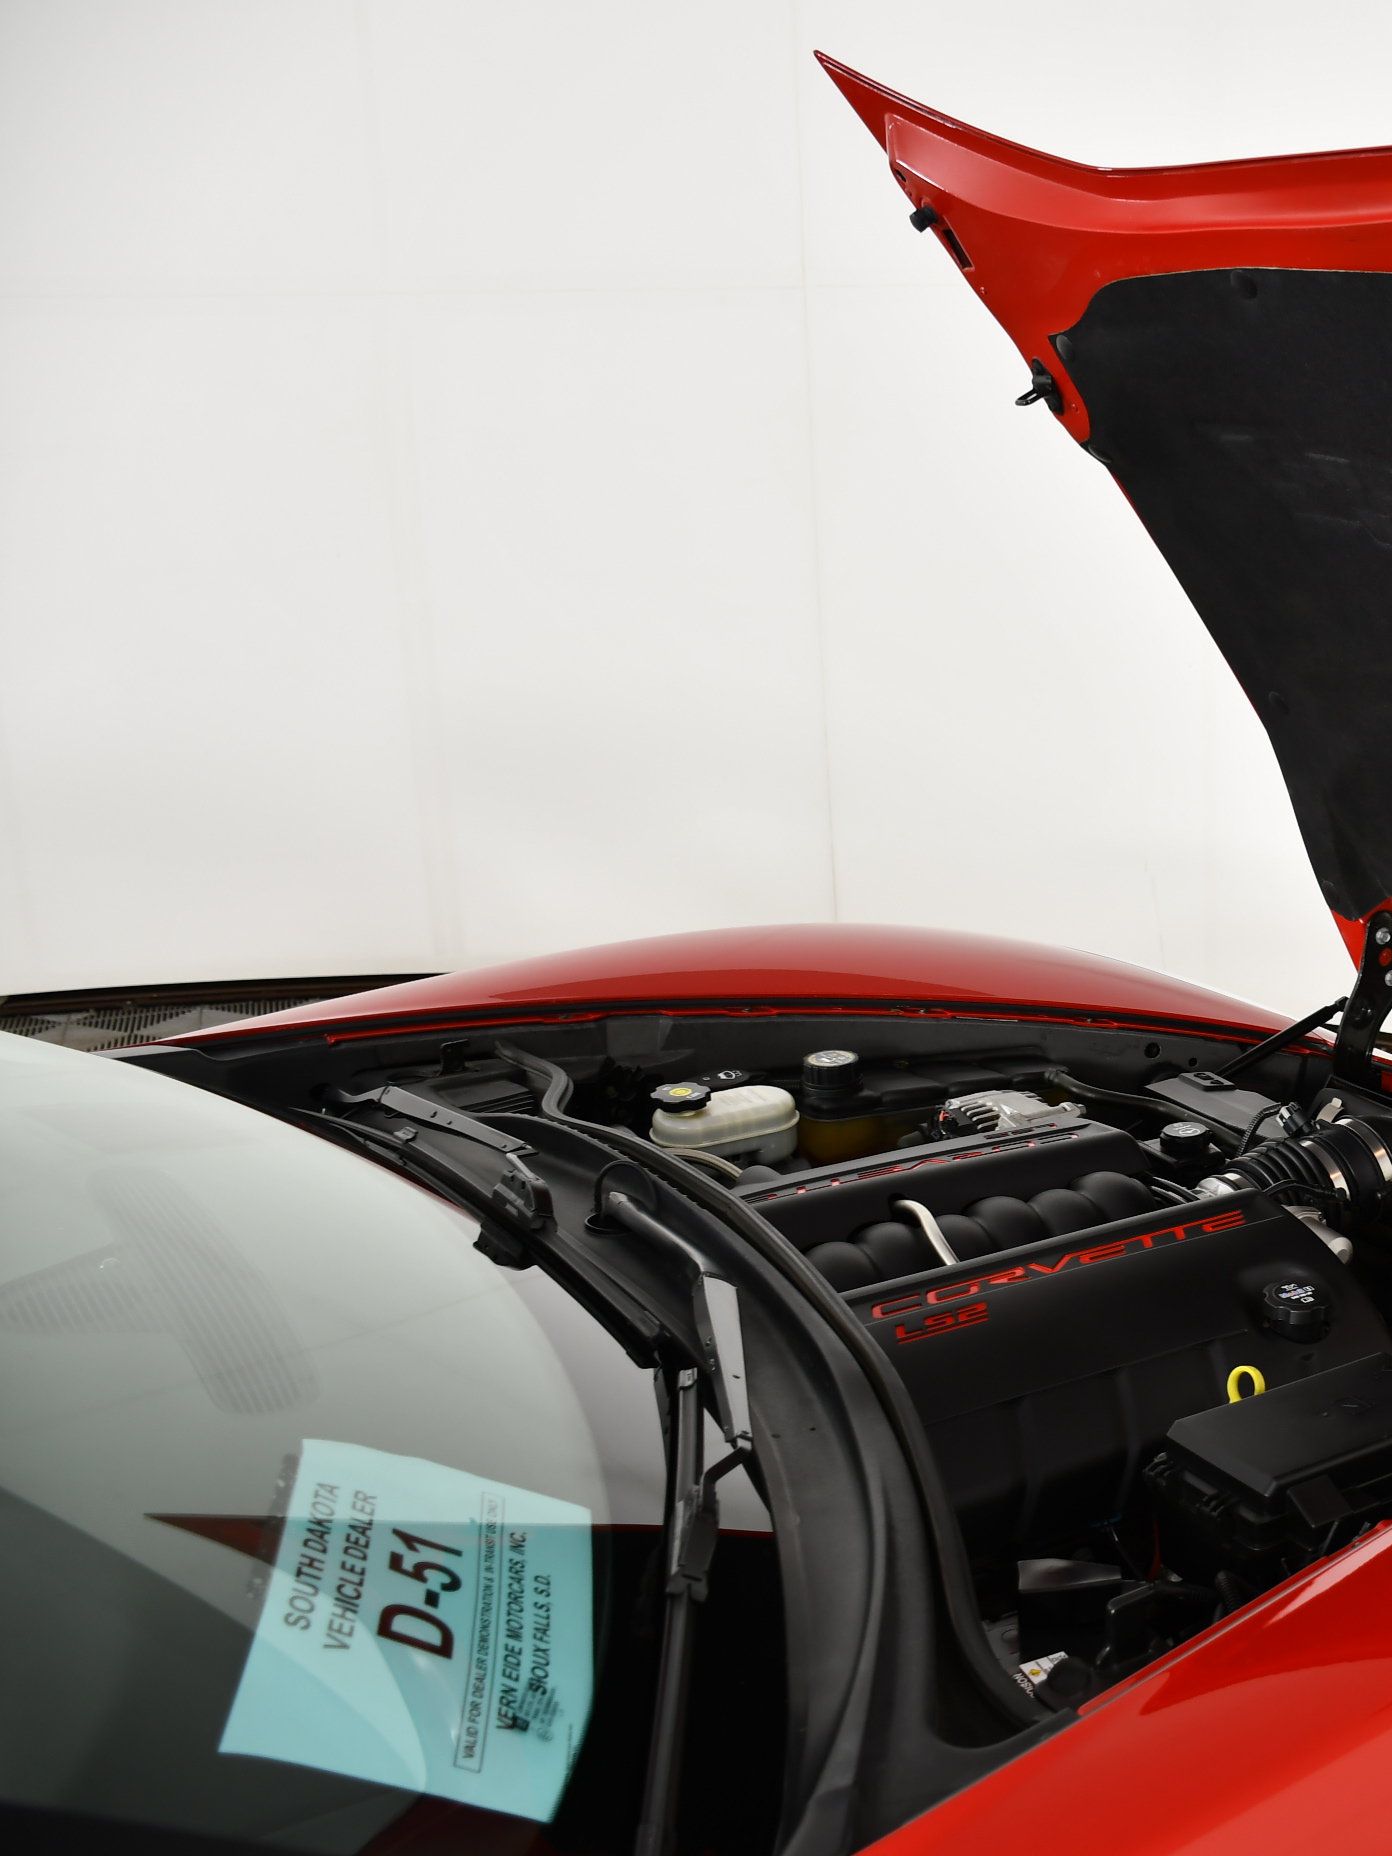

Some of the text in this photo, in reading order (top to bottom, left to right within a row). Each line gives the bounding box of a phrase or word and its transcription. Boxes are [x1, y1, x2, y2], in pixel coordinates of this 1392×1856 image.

[871, 1209, 1246, 1319] CORVETTE
[895, 1302, 989, 1340] LS2
[284, 1483, 340, 1631] SOUTH DAKOTA
[509, 1531, 527, 1556] INC.
[323, 1490, 377, 1650] VEHICLE DEALER
[534, 1574, 551, 1598] S.D.
[377, 1528, 463, 1659] D-51
[472, 1657, 488, 1699] DEALER
[502, 1643, 523, 1682] EIDE
[530, 1644, 550, 1696] SIOUX
[467, 1701, 481, 1725] FOR
[496, 1683, 518, 1730] VERN
[462, 1726, 478, 1758] VALID
